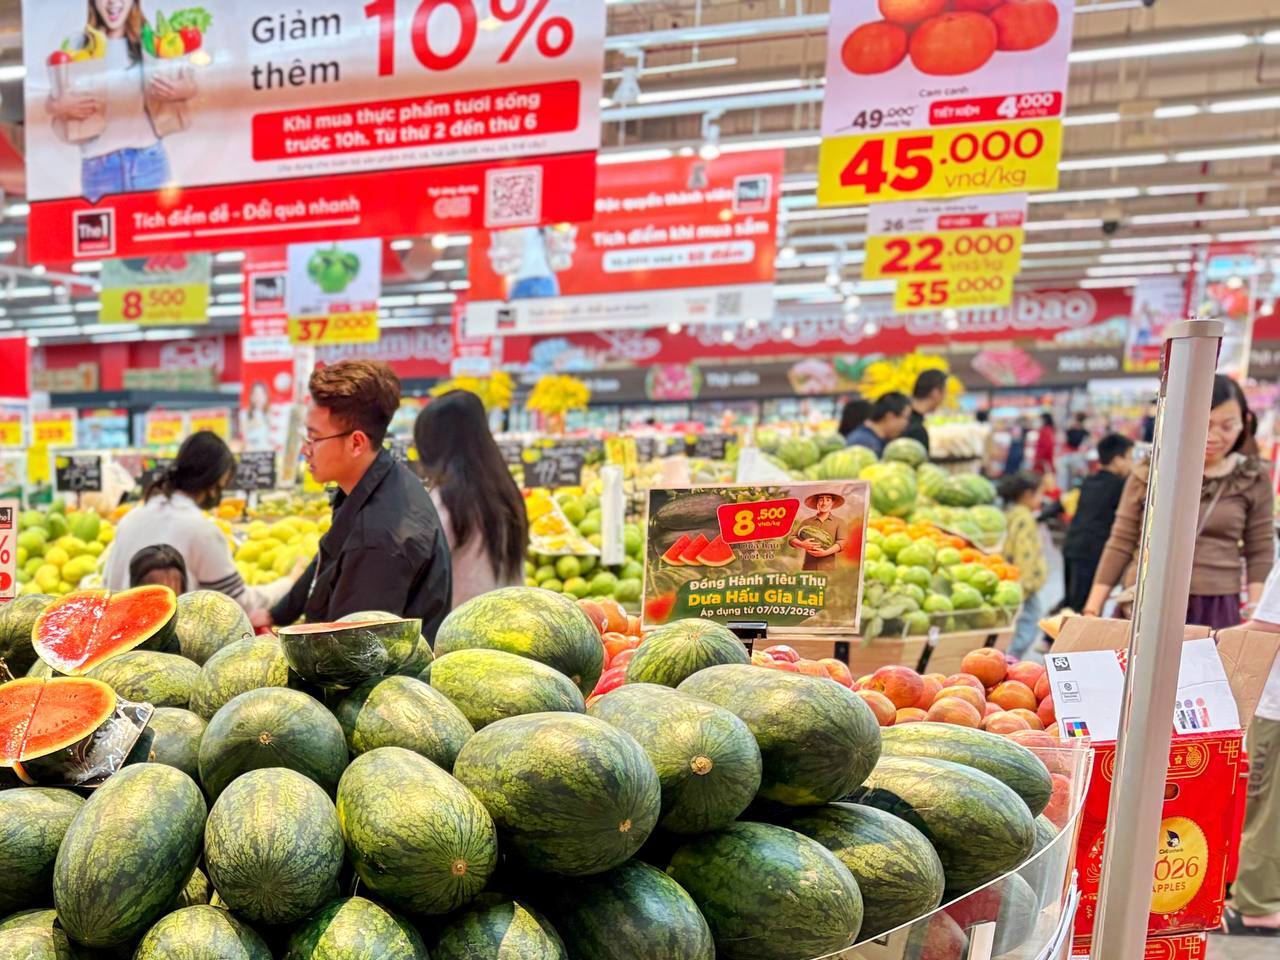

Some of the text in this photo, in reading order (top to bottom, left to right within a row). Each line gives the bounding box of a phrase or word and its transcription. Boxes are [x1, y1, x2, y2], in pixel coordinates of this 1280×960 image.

[252, 10, 341, 44] Giảm
[364, 0, 574, 77] 10%
[252, 58, 340, 90] thêm
[283, 91, 541, 132] Khi mua thực phẩm tươi sống
[285, 133, 330, 153] trước
[374, 127, 396, 145] Từ
[400, 121, 431, 141] thứ
[434, 121, 447, 139] 2
[450, 116, 484, 138] đến
[489, 114, 520, 134] thứ
[524, 113, 538, 131] 6
[945, 167, 1026, 189] vnd/kg
[133, 211, 165, 229] Tích
[167, 204, 206, 227] điểm
[209, 203, 228, 223] dễ
[243, 199, 271, 221] Đổi
[275, 201, 305, 220] quà
[309, 194, 360, 215] nhanh
[688, 587, 823, 607] Dưa Hấu Gia Lai
[689, 572, 826, 591] Đồng Hành Tiêu Thụ
[700, 605, 816, 617] Áp dụng từ 07/03/2026
[1154, 856, 1199, 881] 026
